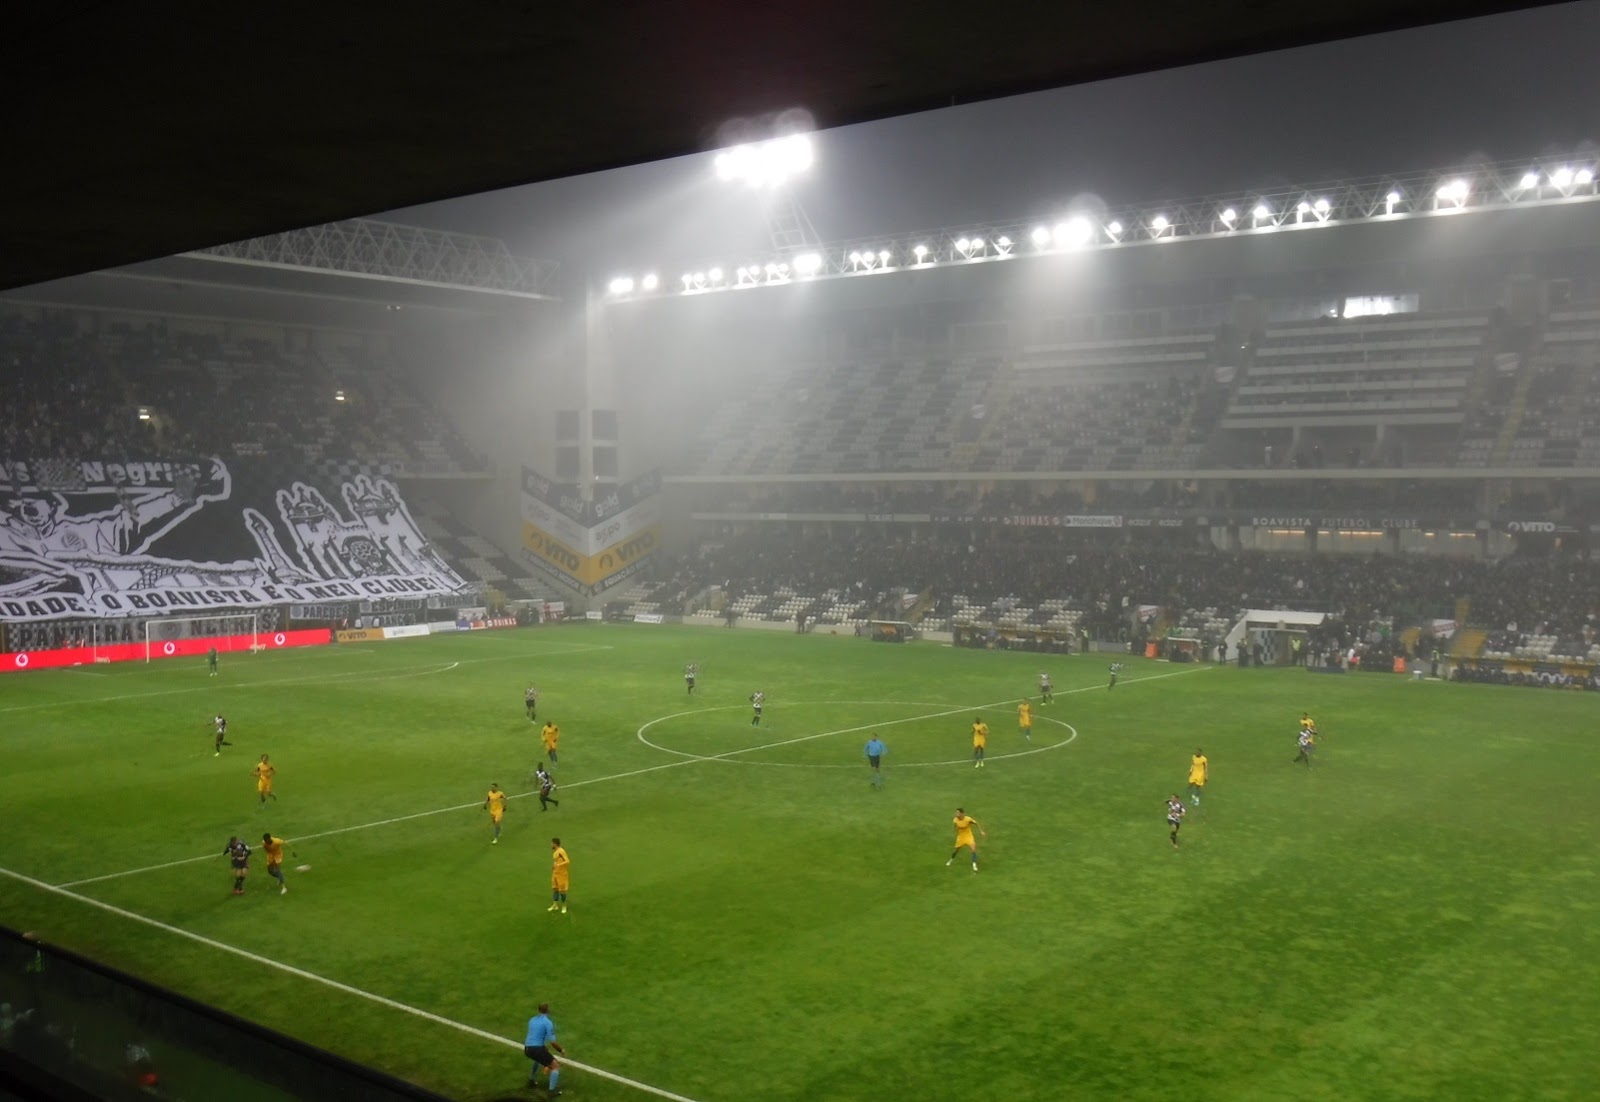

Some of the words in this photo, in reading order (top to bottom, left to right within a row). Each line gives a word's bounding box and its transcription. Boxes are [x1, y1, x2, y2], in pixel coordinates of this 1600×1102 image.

[1252, 517, 1312, 527] BOAVISTA
[1321, 518, 1371, 528] FUTEBOL
[1381, 519, 1420, 528] CLUBE
[1521, 521, 1556, 532] VITO
[101, 594, 123, 609] O
[126, 589, 261, 609] BOAVISTA
[283, 588, 306, 600] O
[305, 583, 361, 598] MEU
[361, 576, 443, 595] CLUBE!
[19, 623, 148, 647] PANTERAS
[347, 631, 367, 639] VITO
